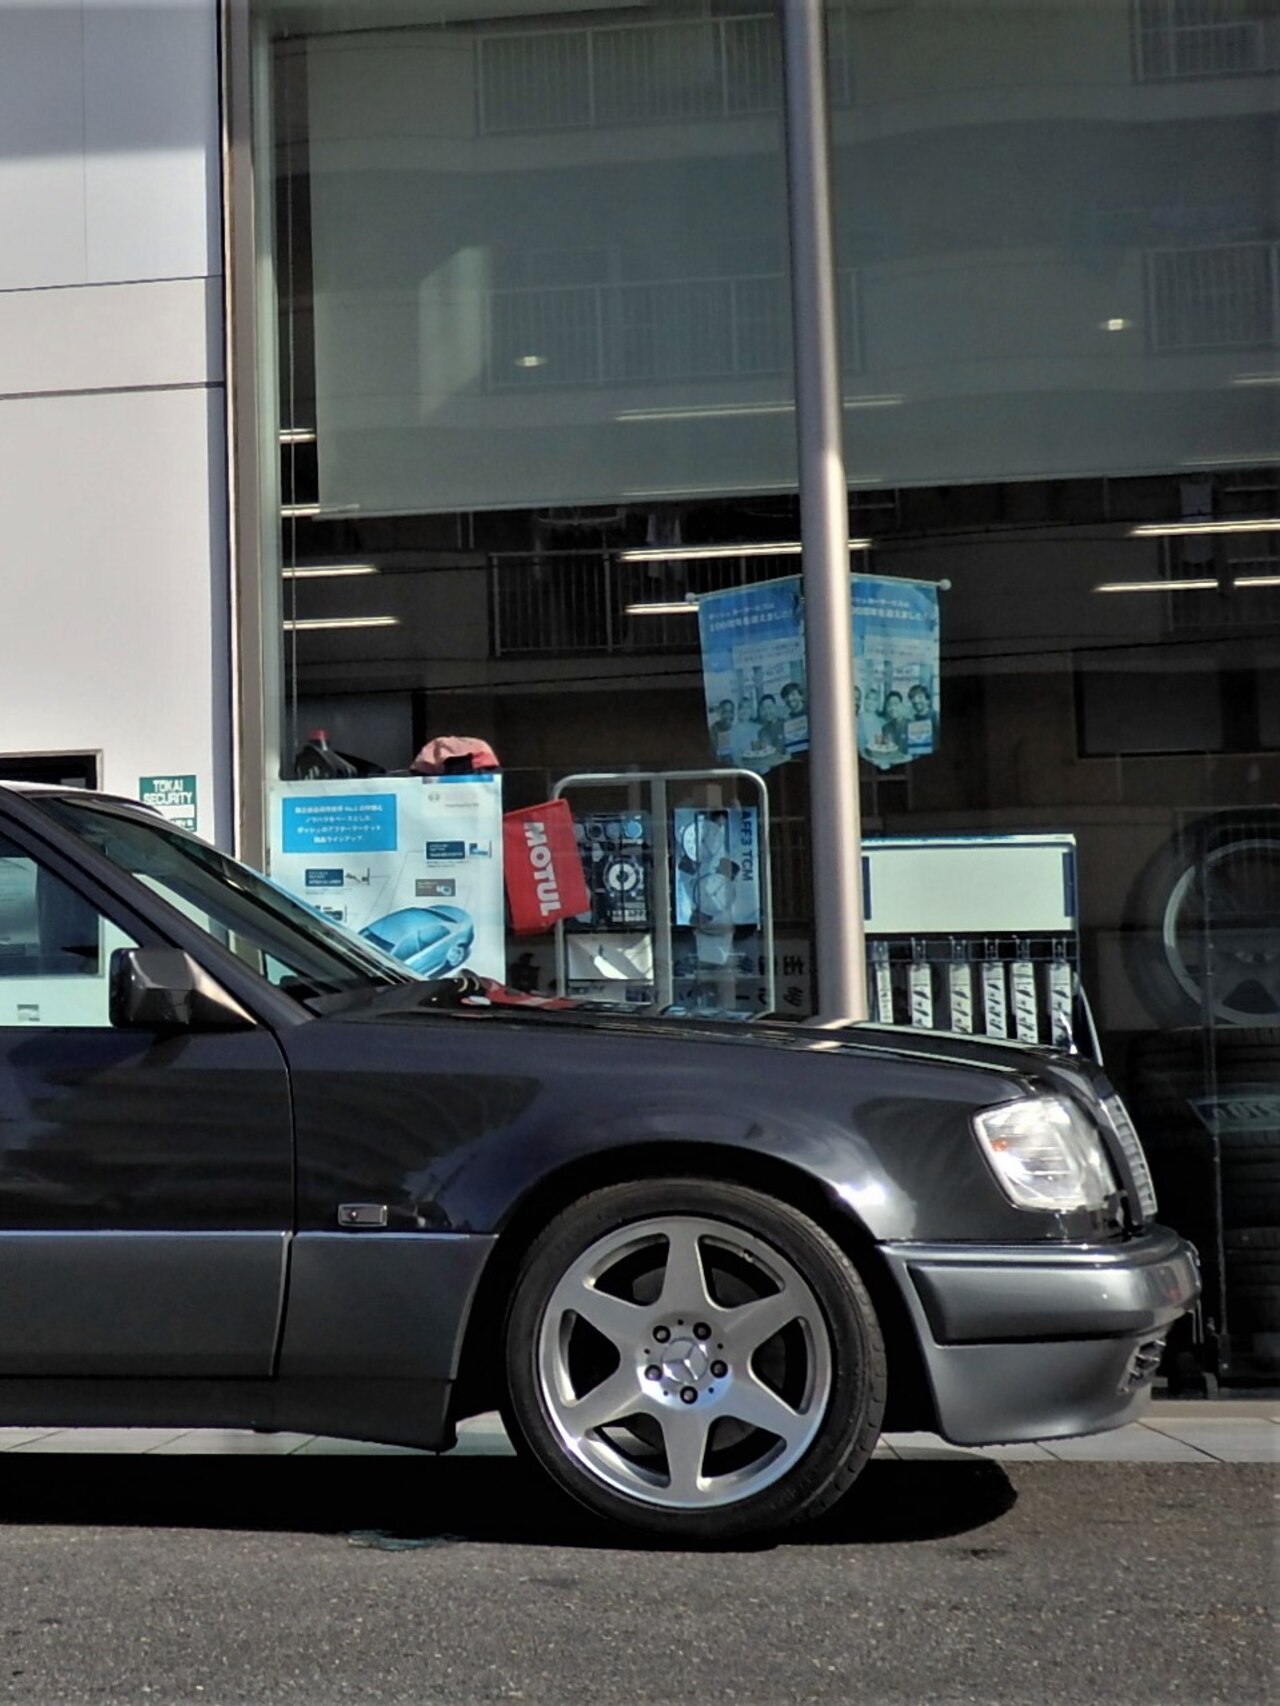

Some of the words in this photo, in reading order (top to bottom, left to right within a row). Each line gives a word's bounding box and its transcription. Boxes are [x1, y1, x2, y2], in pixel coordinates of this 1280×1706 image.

[152, 779, 184, 793] TOKAI
[143, 791, 193, 805] SECURITY
[523, 822, 562, 917] MOTUL
